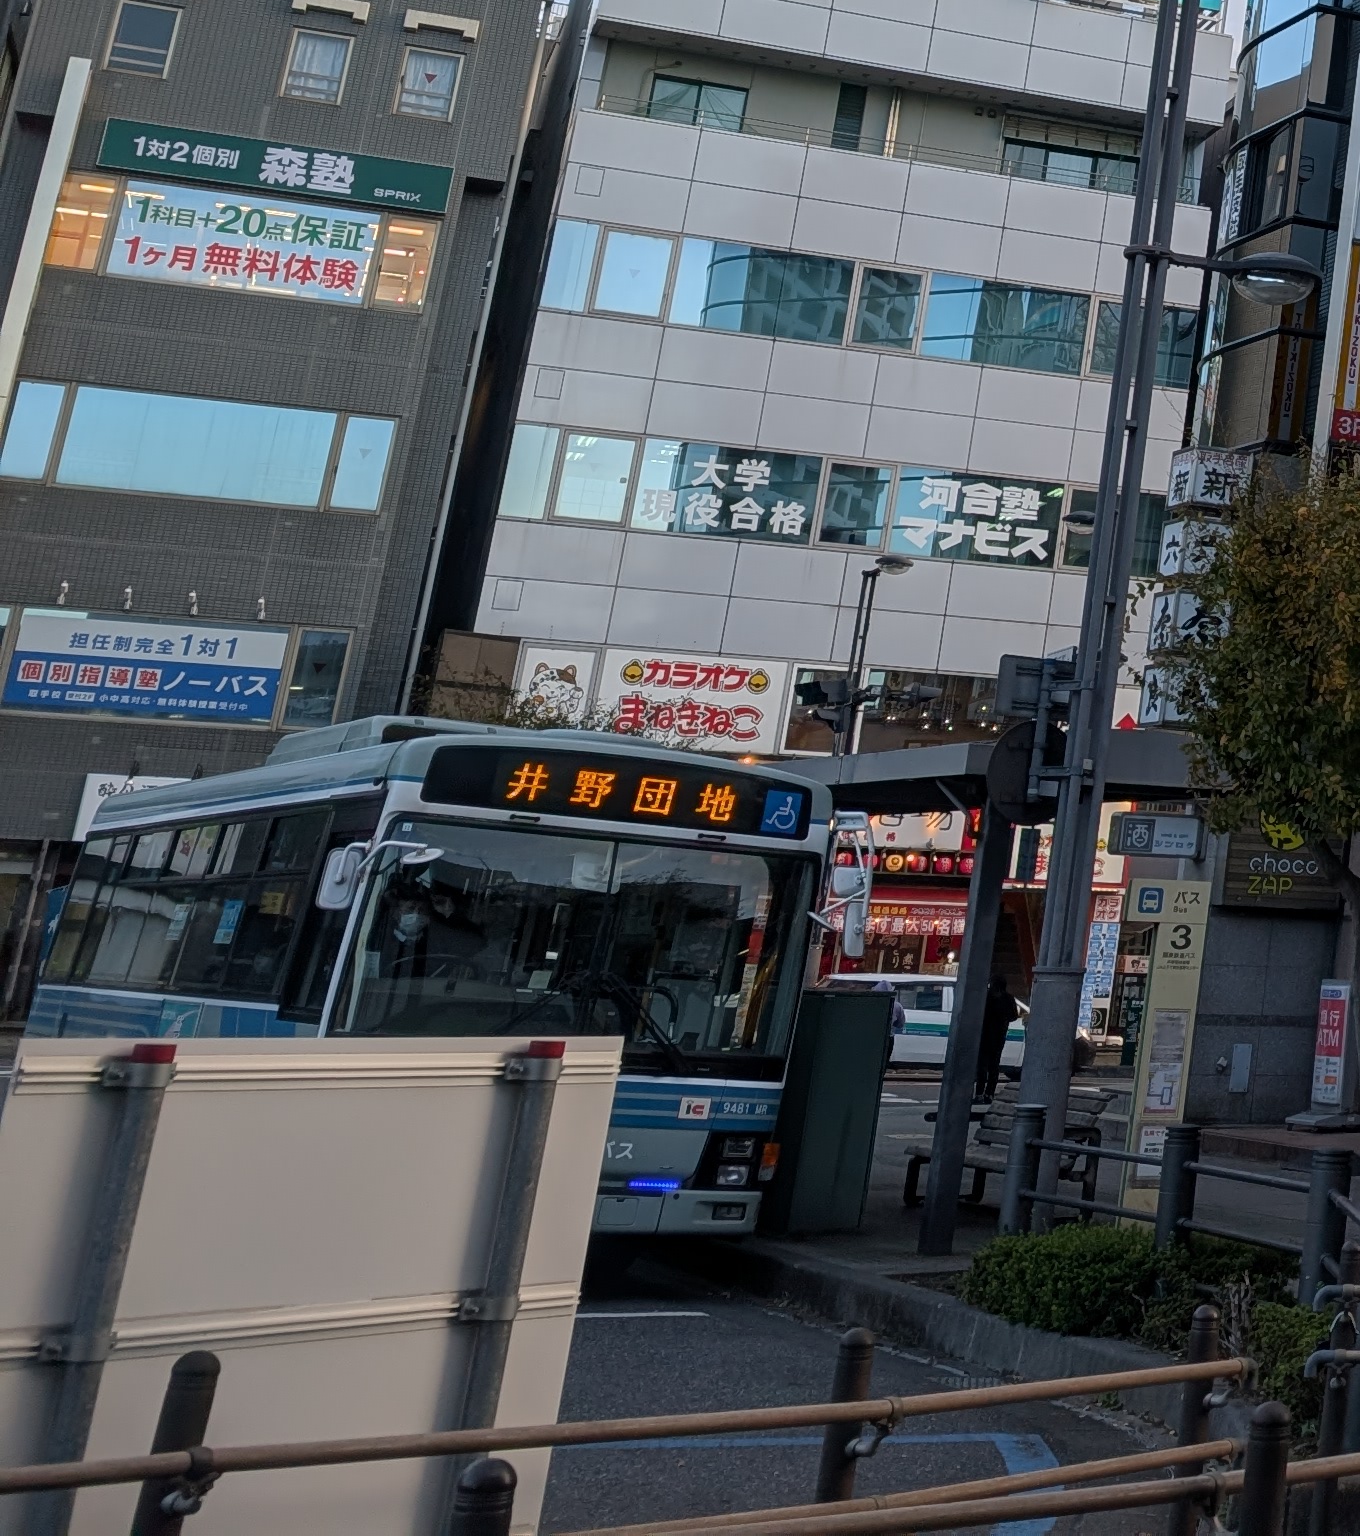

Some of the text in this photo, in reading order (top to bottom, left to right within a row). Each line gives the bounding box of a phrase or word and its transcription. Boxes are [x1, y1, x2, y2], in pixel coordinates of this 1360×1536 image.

[133, 135, 422, 204] 1対2個別 森塾 SPRIX
[692, 457, 772, 493] 大学
[640, 486, 808, 538] 現役合格
[919, 475, 1041, 523] 河合塾
[900, 514, 1051, 562] マナビス
[68, 632, 240, 661] 担任制完全1対1
[641, 659, 750, 694] カラオケ
[614, 692, 763, 743] まねきねこ
[507, 762, 737, 825] 井野団地
[1173, 890, 1201, 906] バス
[1248, 875, 1293, 896] ZAP
[1173, 905, 1189, 915] Bus
[1170, 924, 1192, 951] 3
[723, 1102, 750, 1115] 9481
